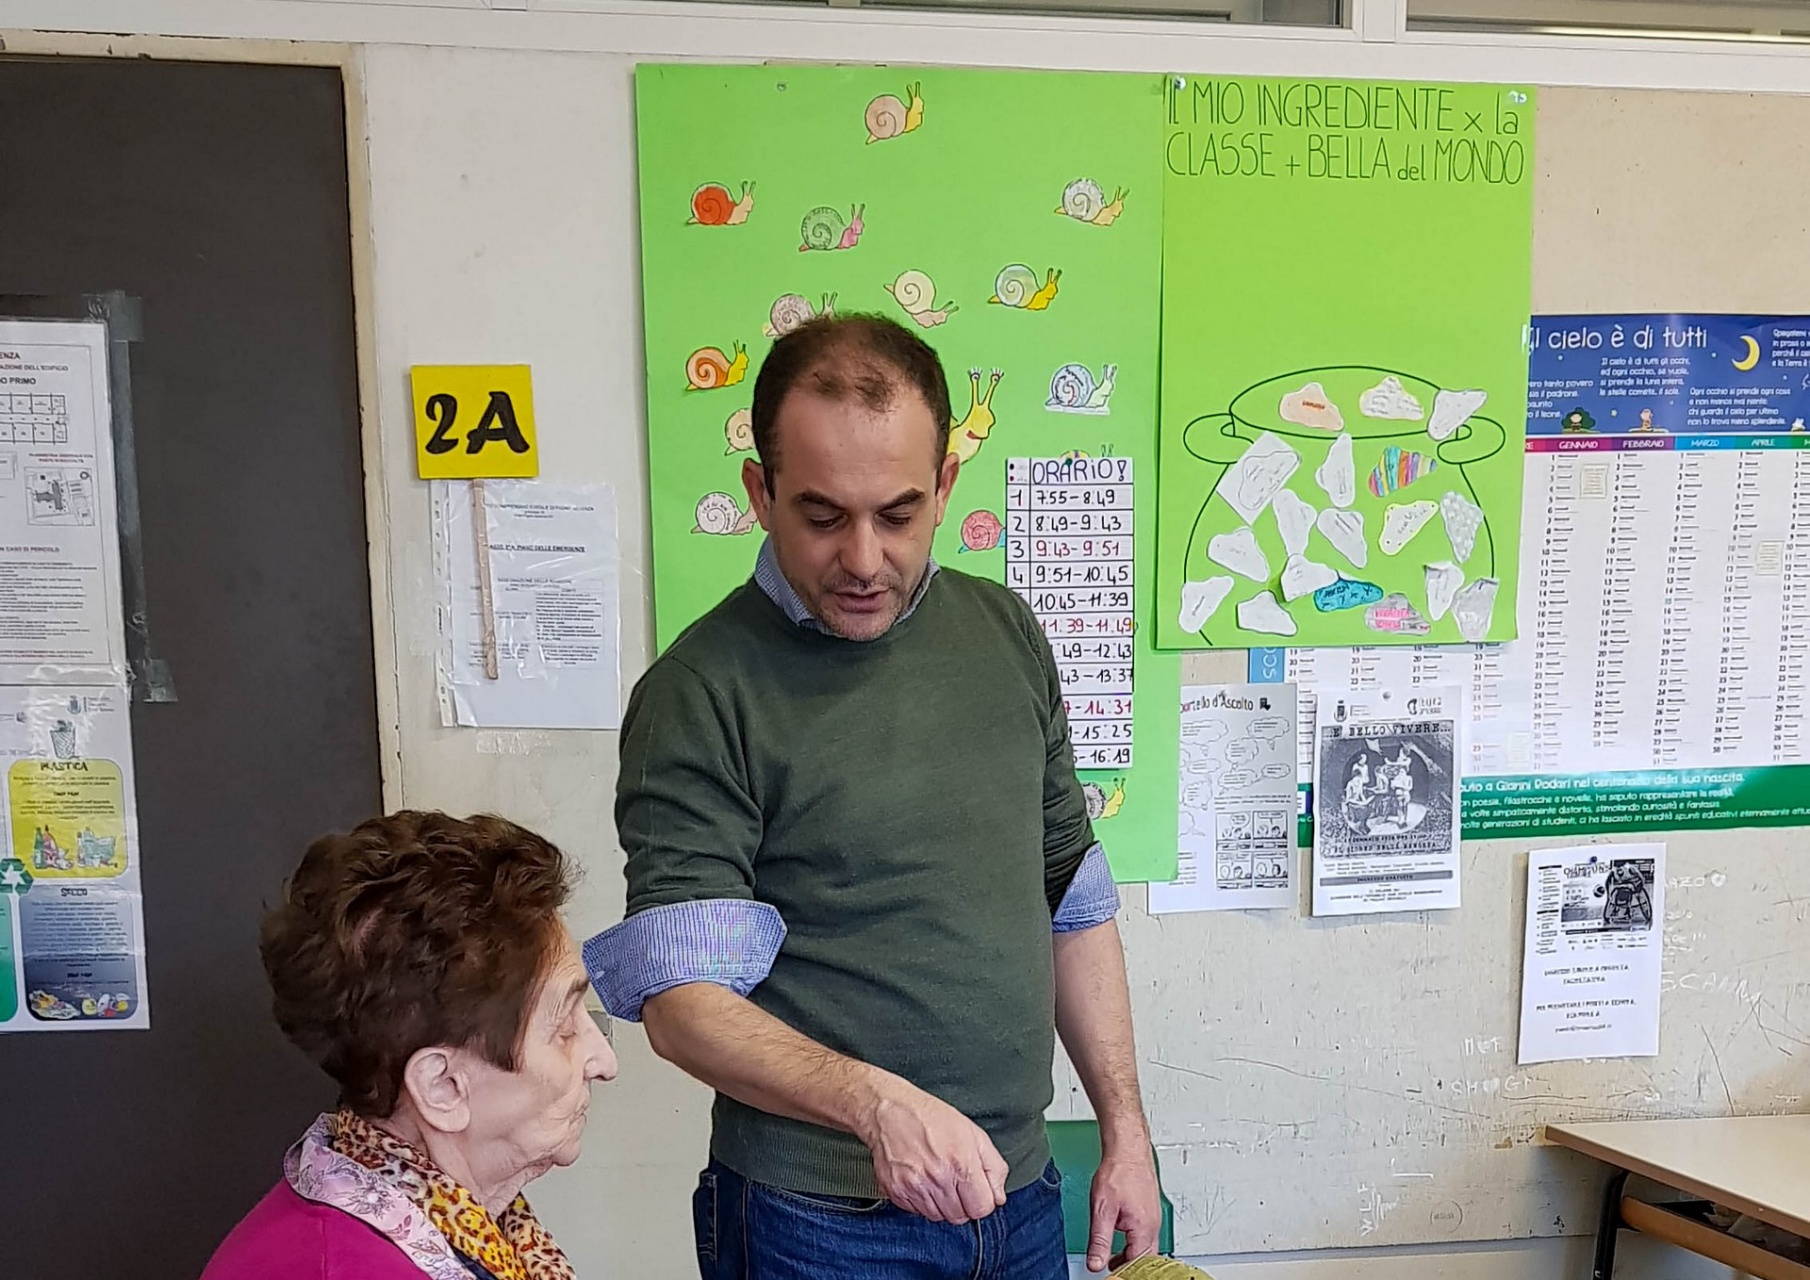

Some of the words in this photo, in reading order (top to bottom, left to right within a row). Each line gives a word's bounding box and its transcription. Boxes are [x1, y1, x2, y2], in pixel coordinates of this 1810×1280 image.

[1194, 80, 1244, 125] MIO
[1258, 83, 1455, 132] INGREDIENTE
[1464, 111, 1483, 133] x
[1496, 91, 1519, 135] la
[1167, 131, 1276, 178] CLASSE
[1285, 154, 1301, 177] +
[1308, 133, 1391, 180] BELLA
[1397, 144, 1427, 182] del
[1434, 138, 1525, 185] MONDO
[1548, 327, 1602, 350] cielo
[1611, 324, 1625, 348] è
[1633, 325, 1654, 350] di
[1663, 326, 1708, 349] tutti
[1772, 348, 1794, 358] perché
[1609, 357, 1627, 366] cielo
[1643, 357, 1659, 365] tutti
[1785, 359, 1802, 367] Terra
[1612, 368, 1628, 376] ogni
[9, 377, 37, 385] PRIMO
[1544, 379, 1564, 388] tanto
[1565, 380, 1594, 389] povero
[1607, 377, 1634, 388] prende
[1644, 377, 1660, 386] luna
[1607, 388, 1627, 396] stelle
[1690, 387, 1705, 396] Ogni
[1706, 387, 1728, 395] occhio
[1736, 387, 1759, 396] prende
[1760, 388, 1775, 396] ogni
[1700, 408, 1724, 416] guarda
[1758, 407, 1779, 415] ultimo
[425, 390, 531, 456] 2A
[1687, 418, 1702, 426] non
[1711, 417, 1730, 425] trova
[1559, 440, 1599, 450] GENNAIO
[1622, 439, 1665, 449] FEBBRAIO
[1691, 438, 1720, 448] MARZO
[1751, 438, 1776, 447] APRILE
[1013, 516, 1026, 533] 2
[1010, 540, 1025, 559] 3
[1349, 725, 1386, 737] BELLO
[40, 761, 88, 771] PLASTICA
[1485, 782, 1494, 791] a
[1496, 780, 1531, 790] Gianni
[1534, 778, 1571, 790] Rodari
[1573, 777, 1590, 788] nel
[1504, 796, 1553, 805] filastrocche
[1595, 793, 1607, 801] ha
[1608, 792, 1638, 802] saputo
[1639, 789, 1698, 801] rappresentare
[1470, 808, 1491, 818] volte
[1492, 806, 1557, 818] simpaticamente
[1595, 802, 1640, 813] stimolando
[1641, 800, 1677, 811] curiosità
[1482, 818, 1531, 829] generazioni
[1588, 814, 1600, 823] ha
[1600, 814, 1633, 823] lasciato
[1644, 810, 1673, 821] eredità
[1674, 810, 1701, 821] spunti
[1701, 809, 1739, 819] educativi
[1740, 808, 1791, 818] eternamente
